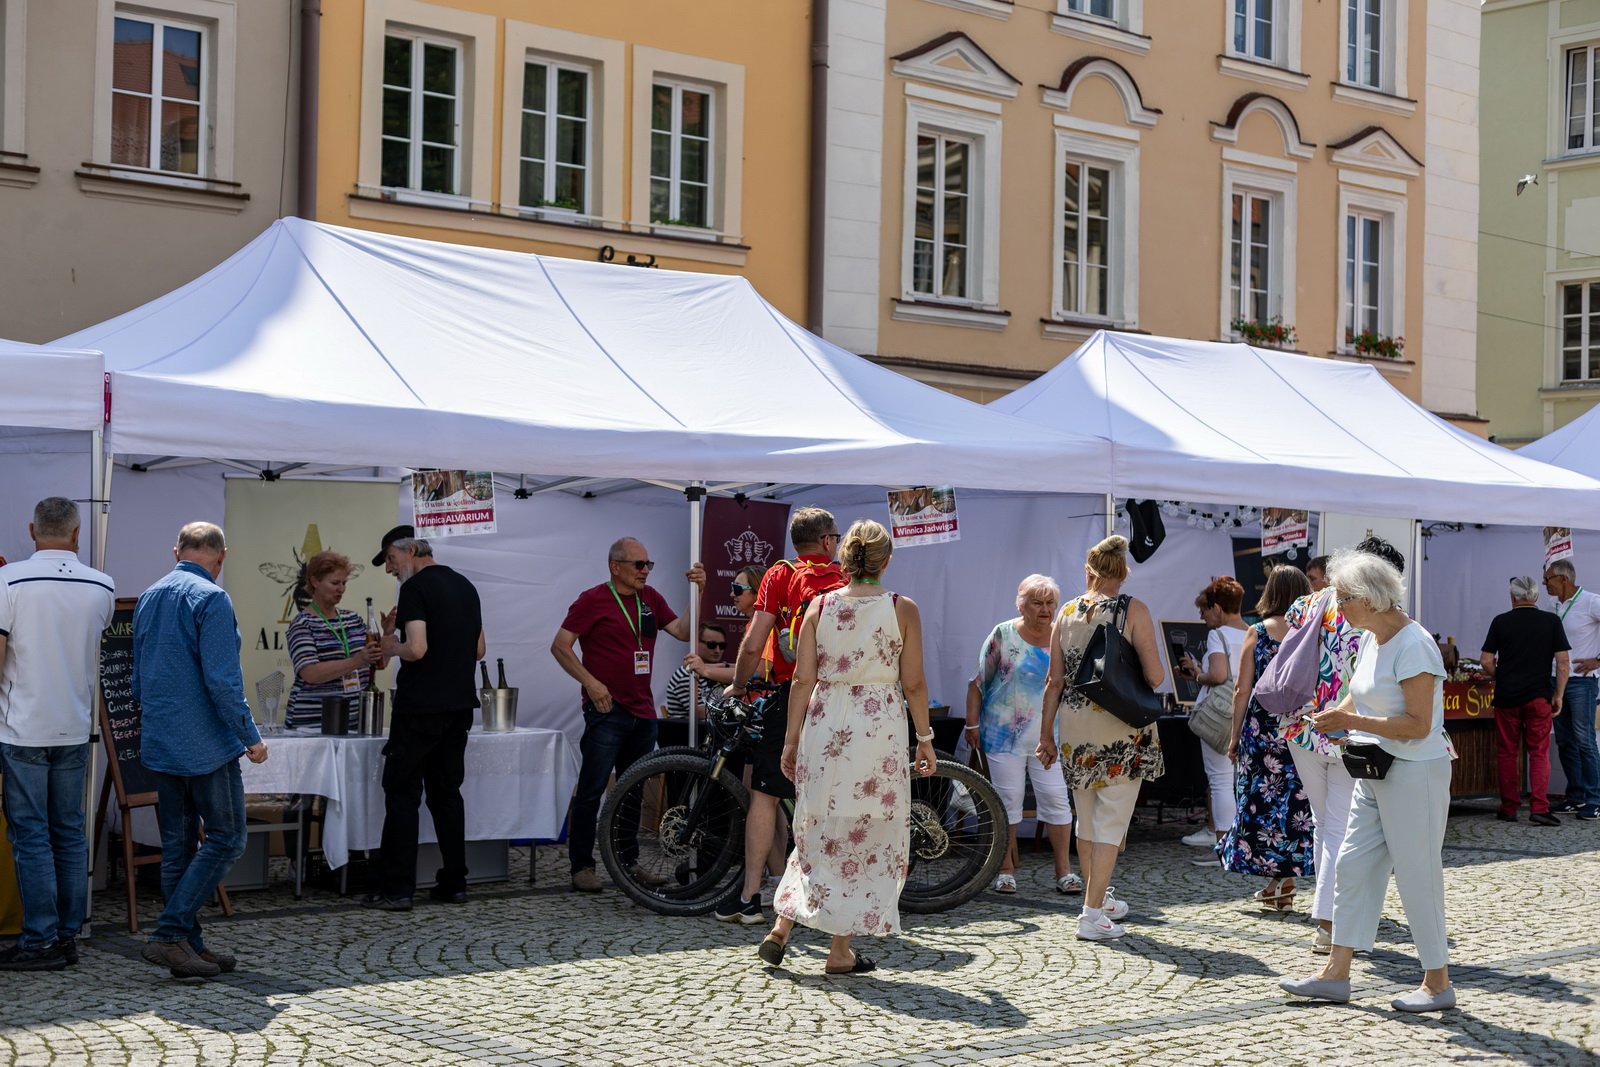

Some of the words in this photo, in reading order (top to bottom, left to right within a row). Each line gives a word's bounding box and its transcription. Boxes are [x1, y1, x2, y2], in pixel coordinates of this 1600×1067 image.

[417, 516, 445, 525] Winnica
[445, 512, 489, 523] ALVARIUM
[896, 527, 923, 536] Winnica
[924, 523, 954, 534] Jadwiga
[717, 569, 736, 577] WINNI
[255, 627, 283, 650] AL
[1443, 690, 1460, 711] ica
[1466, 685, 1495, 717] Świ
